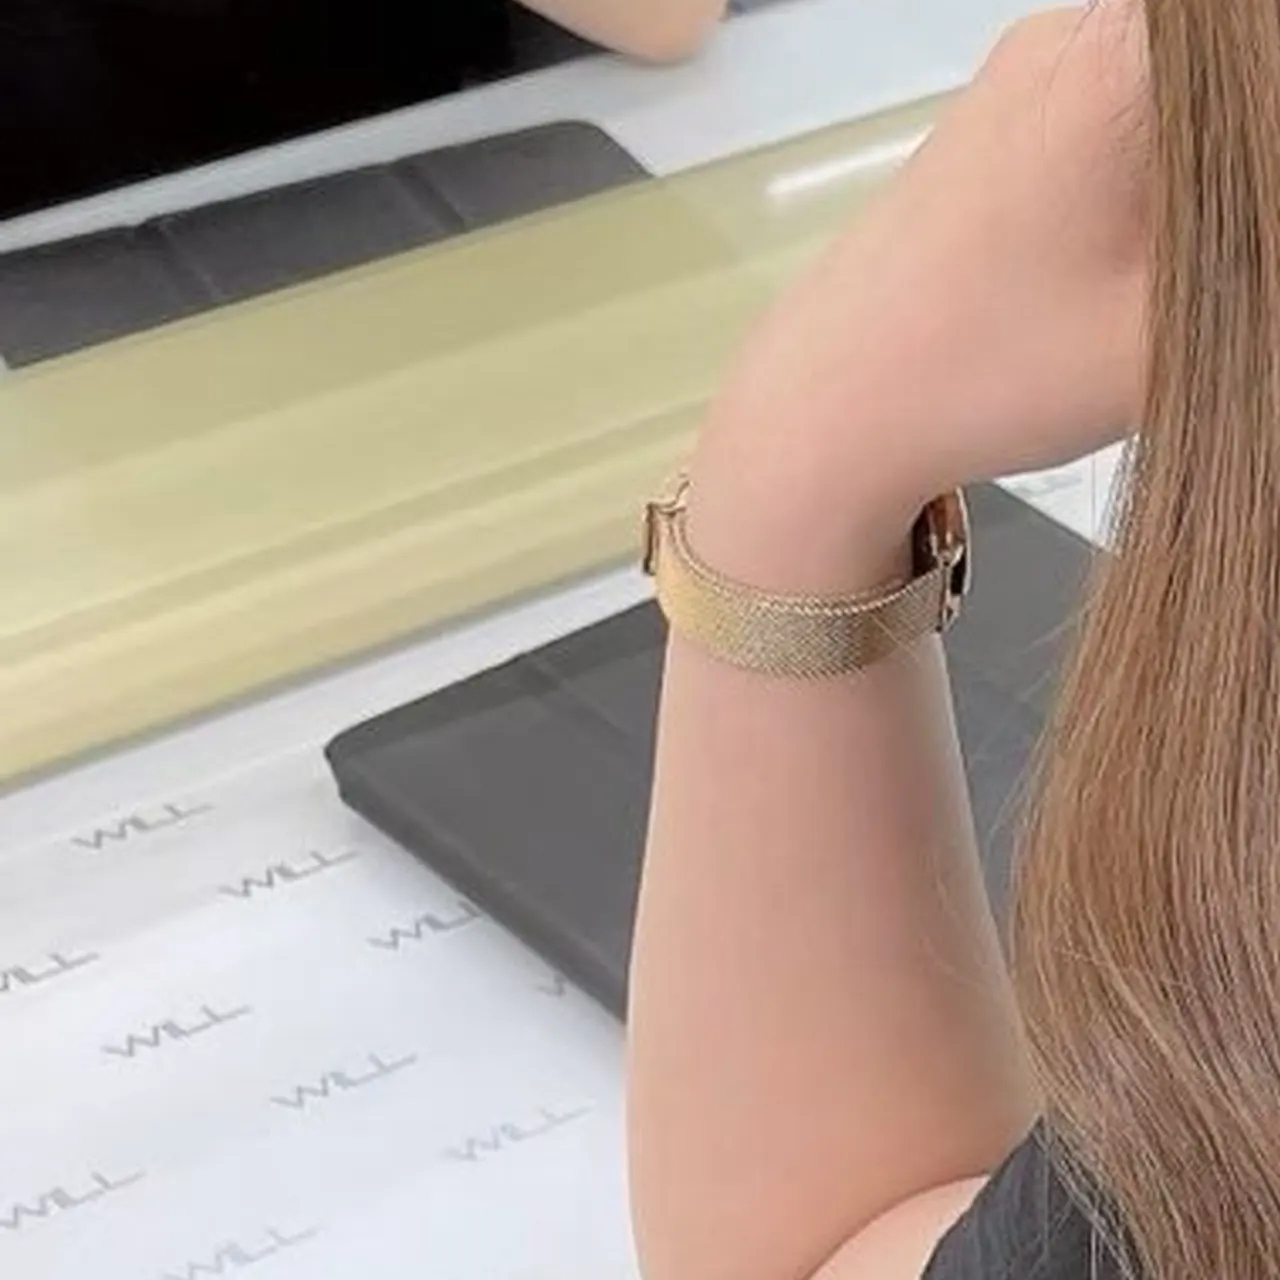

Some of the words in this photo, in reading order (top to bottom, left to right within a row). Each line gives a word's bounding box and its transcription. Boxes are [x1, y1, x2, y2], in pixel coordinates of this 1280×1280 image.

[71, 802, 216, 851] WILL
[217, 850, 361, 899] WILL
[101, 1004, 255, 1059] WILL
[270, 1052, 419, 1111] WILL
